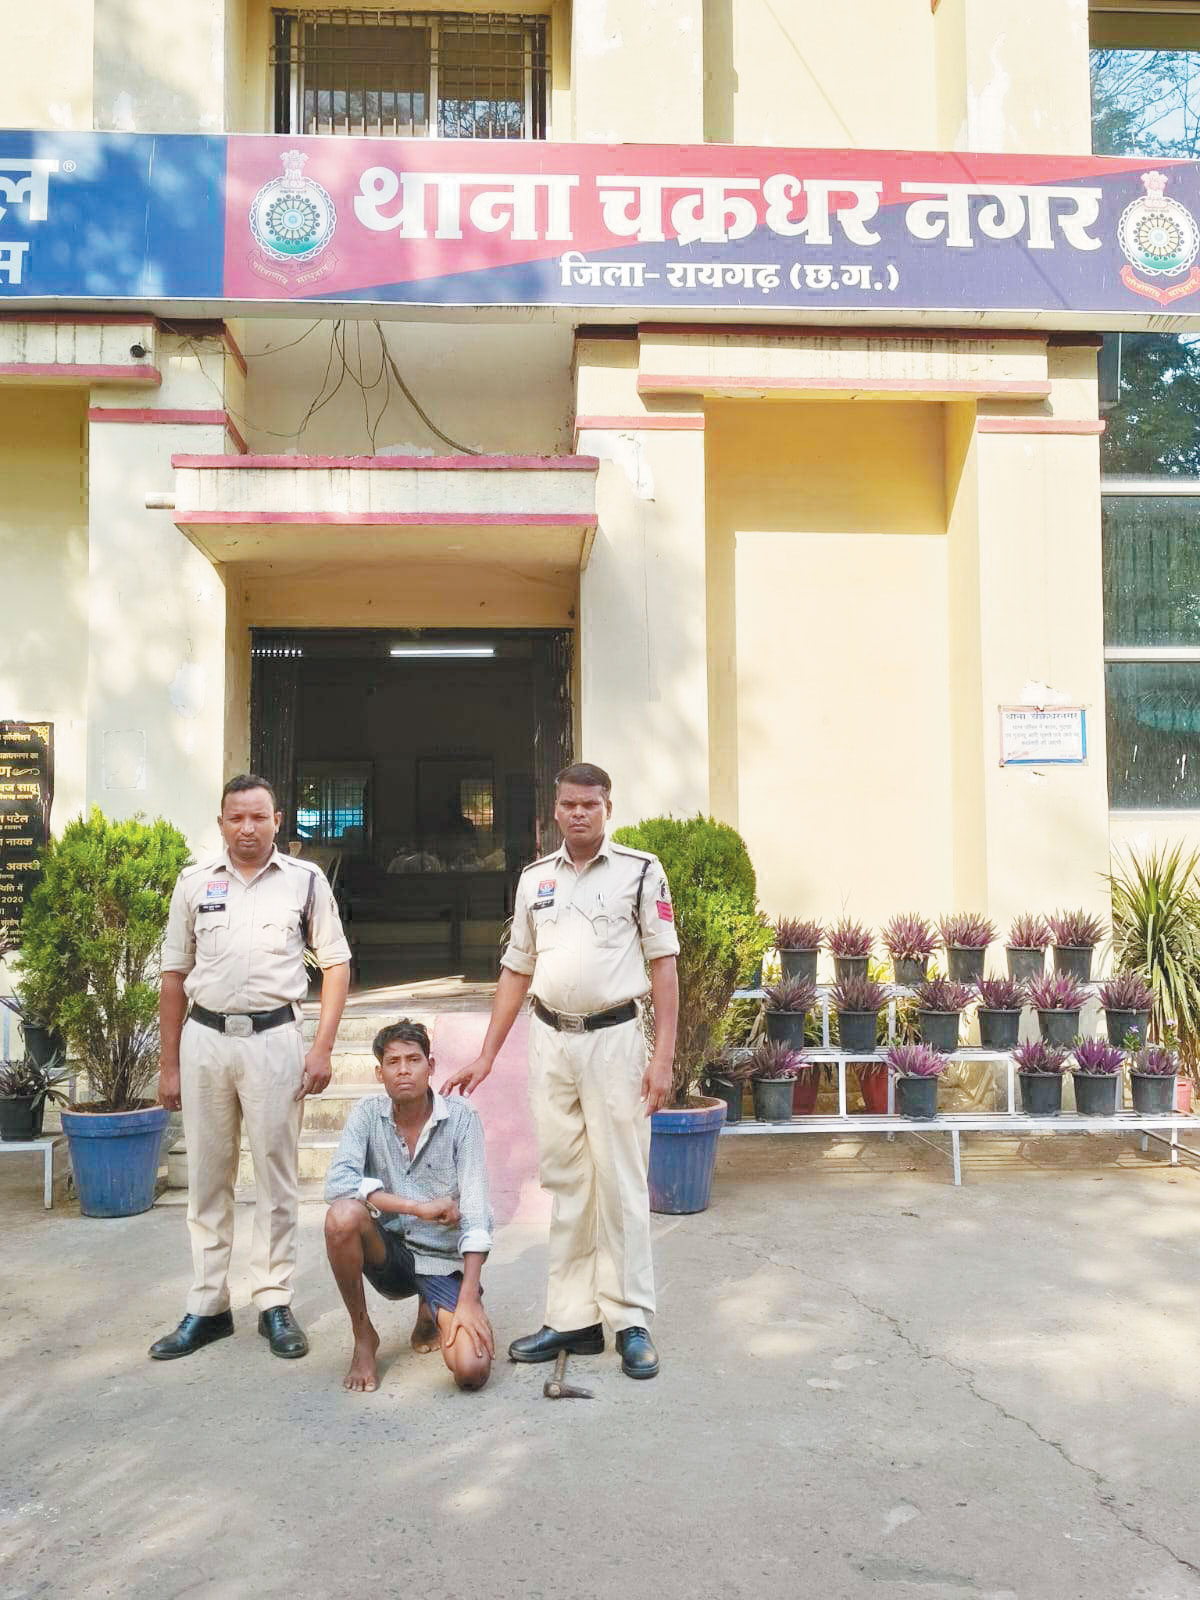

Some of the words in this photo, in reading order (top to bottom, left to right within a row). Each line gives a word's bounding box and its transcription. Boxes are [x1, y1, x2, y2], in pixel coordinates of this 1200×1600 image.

[353, 166, 580, 240] थाना
[596, 173, 883, 247] चक्रधर
[900, 182, 1103, 251] नगर
[666, 263, 780, 294] रायगढ़
[790, 263, 899, 292] (छ.ग.)
[1, 896, 24, 904] 2020
